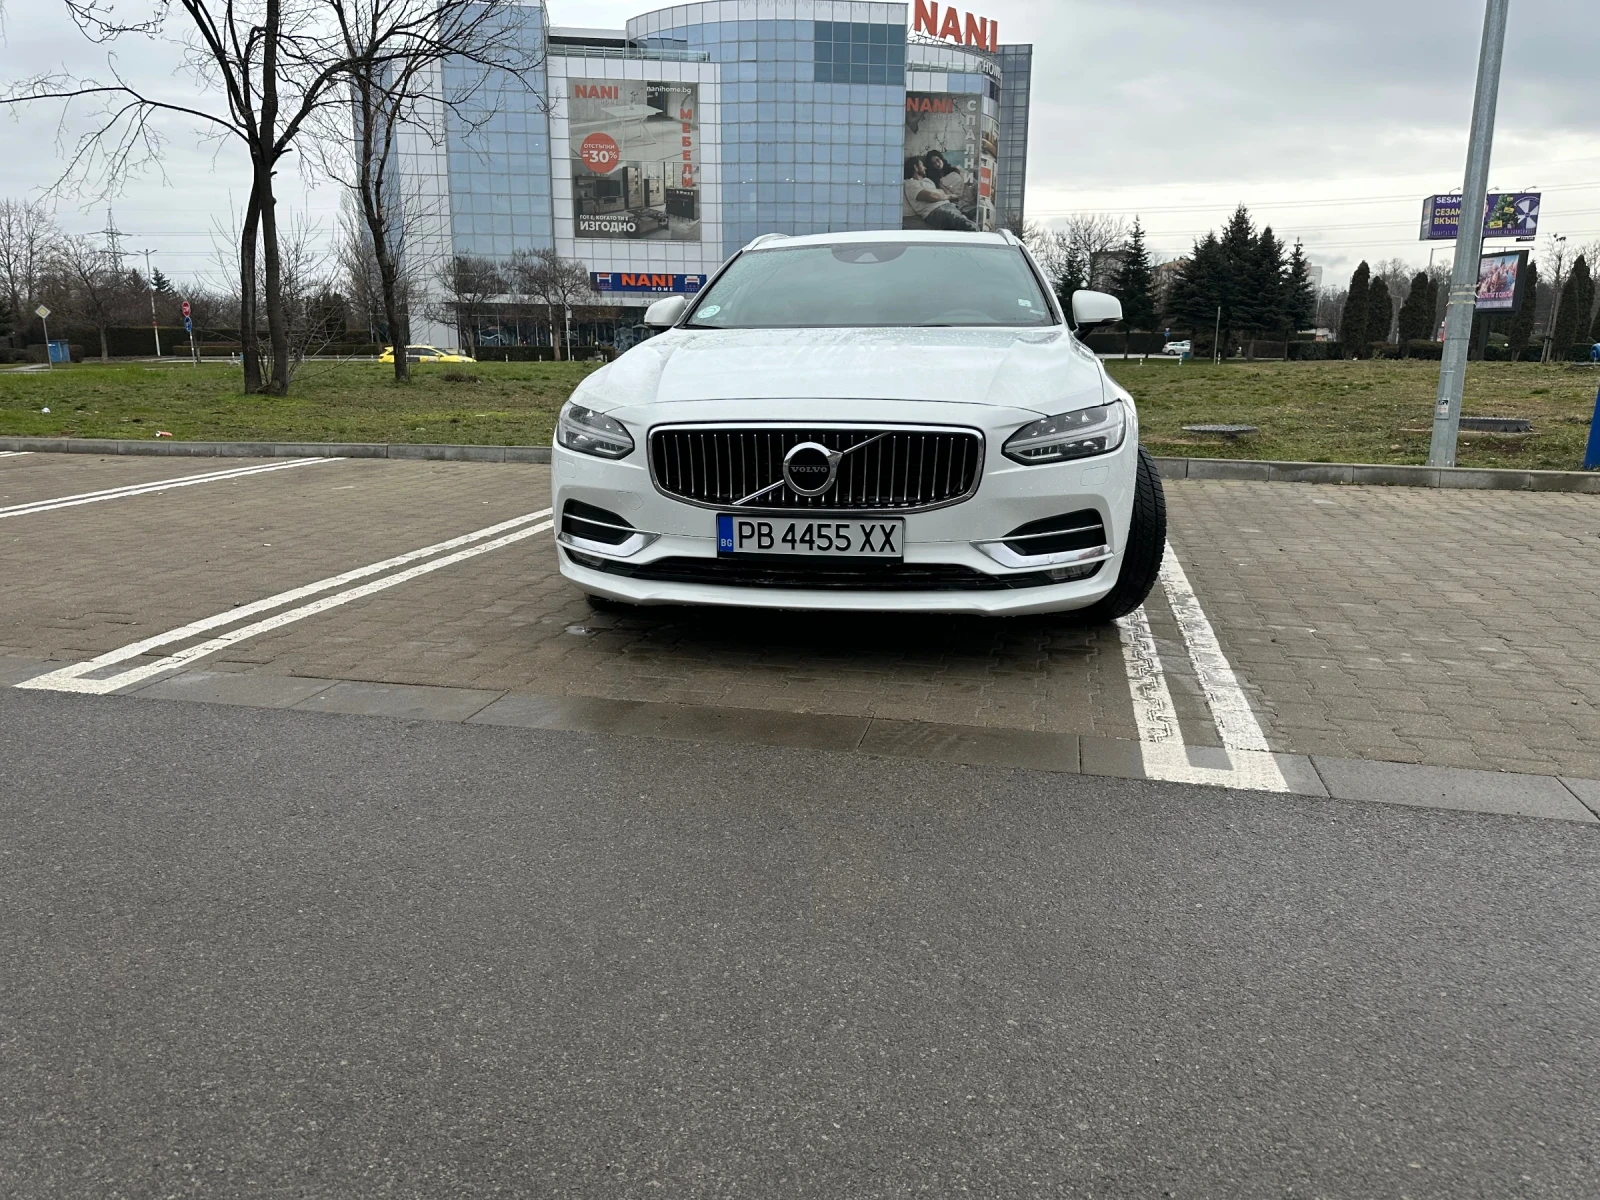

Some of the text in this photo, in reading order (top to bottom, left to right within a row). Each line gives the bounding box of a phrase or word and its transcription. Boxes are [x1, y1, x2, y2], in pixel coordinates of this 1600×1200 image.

[914, 0, 998, 53] NANI
[574, 84, 619, 99] NANI
[647, 86, 692, 94] nanihome.bg
[906, 97, 953, 113] NANI
[680, 108, 693, 188] МЕБЕЛИ
[963, 100, 977, 183] СПАЛНИ
[1436, 196, 1462, 204] SESAM
[579, 220, 636, 233] ИЗГОДНО
[1434, 217, 1459, 225] ВКЪЩ
[621, 273, 674, 287] NANI
[720, 538, 733, 547] BG
[738, 521, 897, 552] PB 4455 XX
